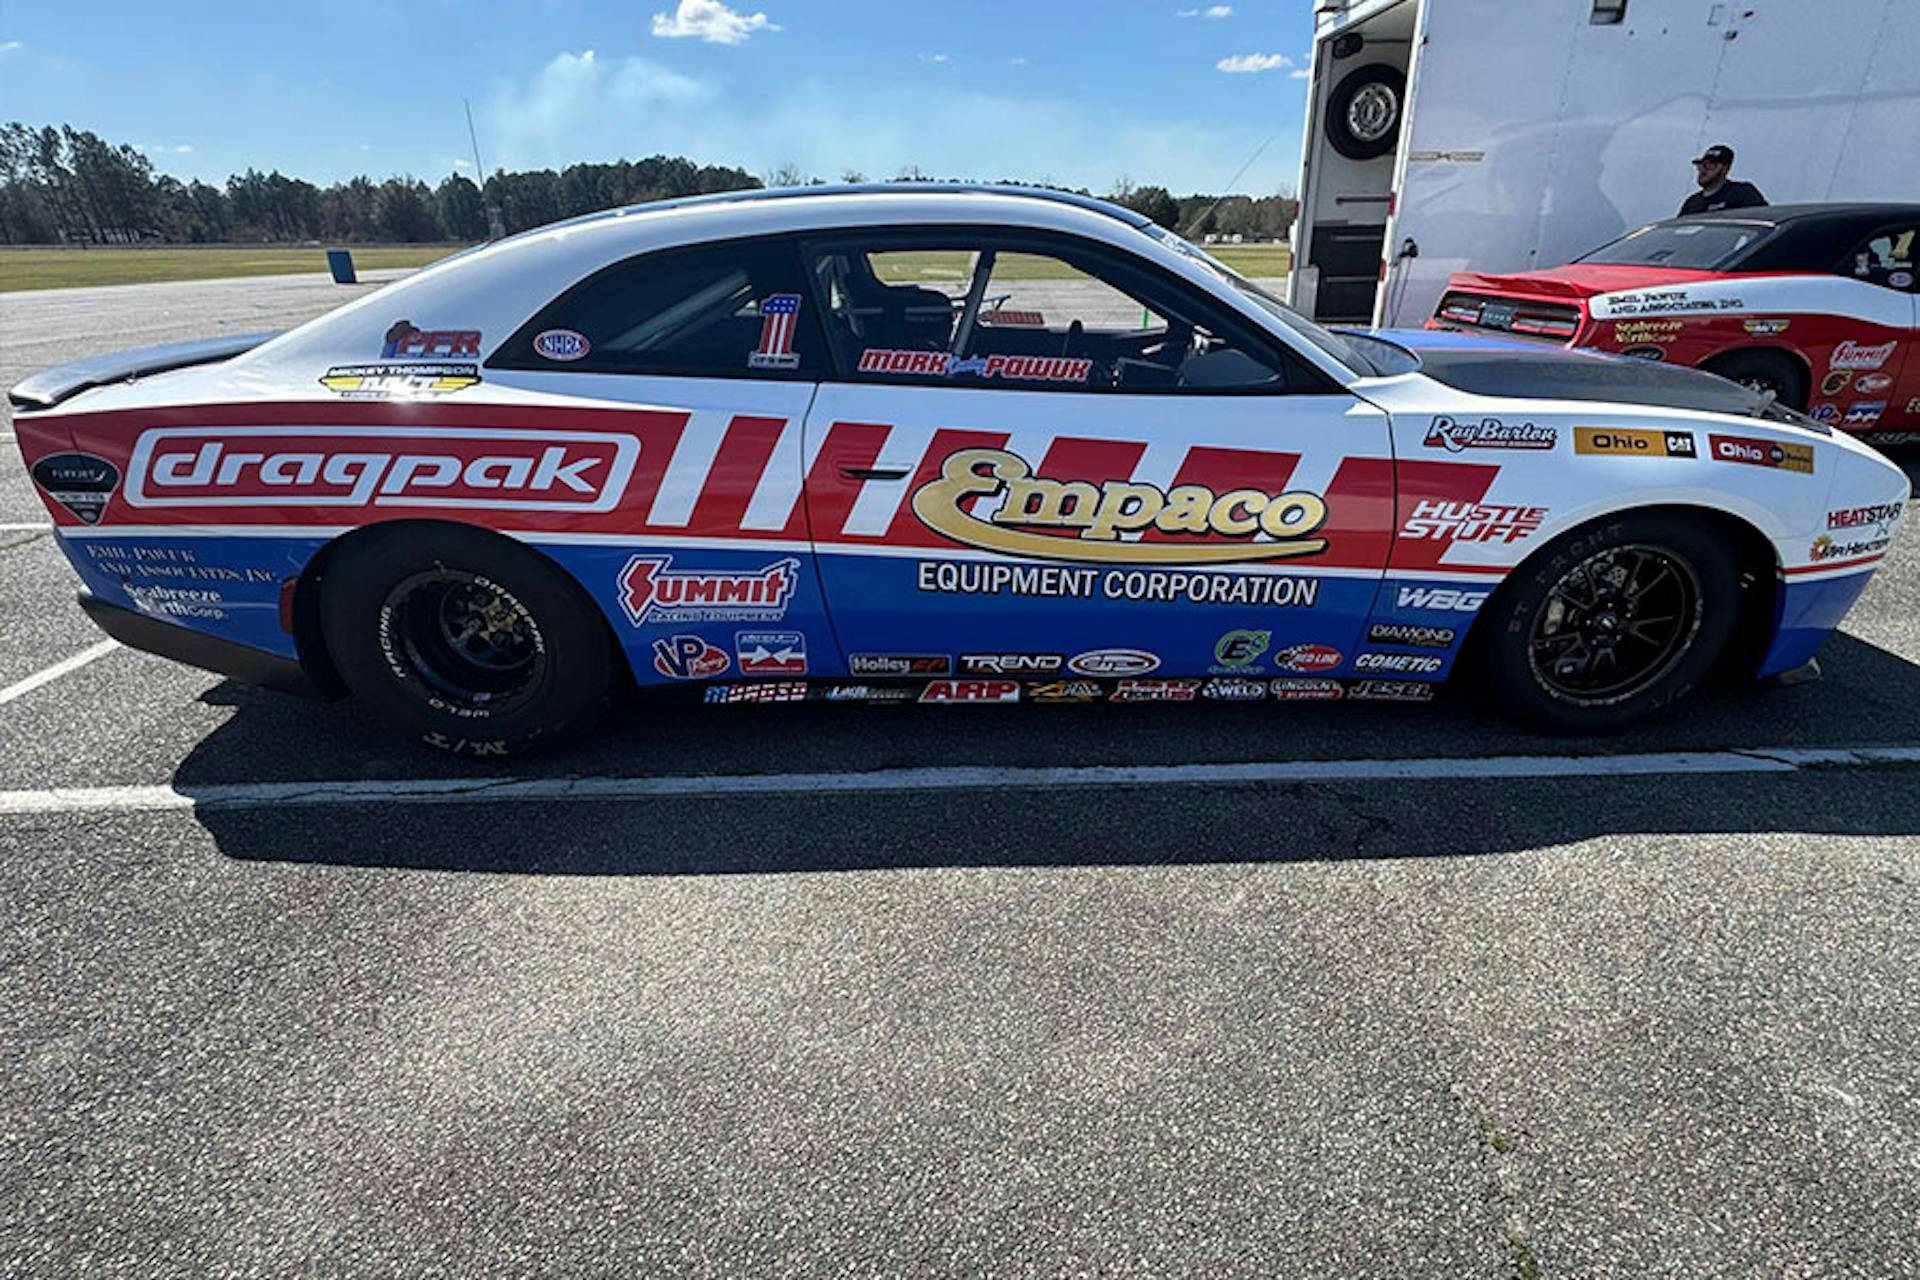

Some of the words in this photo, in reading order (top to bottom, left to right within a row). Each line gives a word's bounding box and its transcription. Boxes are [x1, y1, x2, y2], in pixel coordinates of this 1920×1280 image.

[542, 339, 582, 352] NHRA
[329, 367, 386, 377] MICKEY
[389, 365, 475, 376] THOMPSON
[1427, 415, 1480, 452] Ray
[1480, 418, 1557, 441] Barton
[1593, 435, 1649, 449] Ohio
[1667, 436, 1693, 451] CAT
[1719, 442, 1764, 460] Ohio
[152, 440, 603, 505] dragpak
[912, 448, 1330, 566] Empaco
[1828, 503, 1903, 526] HEATSTAR
[1398, 519, 1538, 544] STUFF
[123, 583, 221, 601] Seabreeze
[917, 561, 1099, 598] EQUIPMENT
[1102, 569, 1319, 606] CORPORATION
[1396, 587, 1491, 611] WBG
[1371, 624, 1454, 641] DIAMOND
[654, 636, 705, 677] VP
[854, 656, 909, 675] Holley
[961, 656, 1062, 673] TREND
[1355, 653, 1442, 673] COMETIC
[918, 681, 1018, 702] ARP
[1215, 685, 1263, 698] WELD
